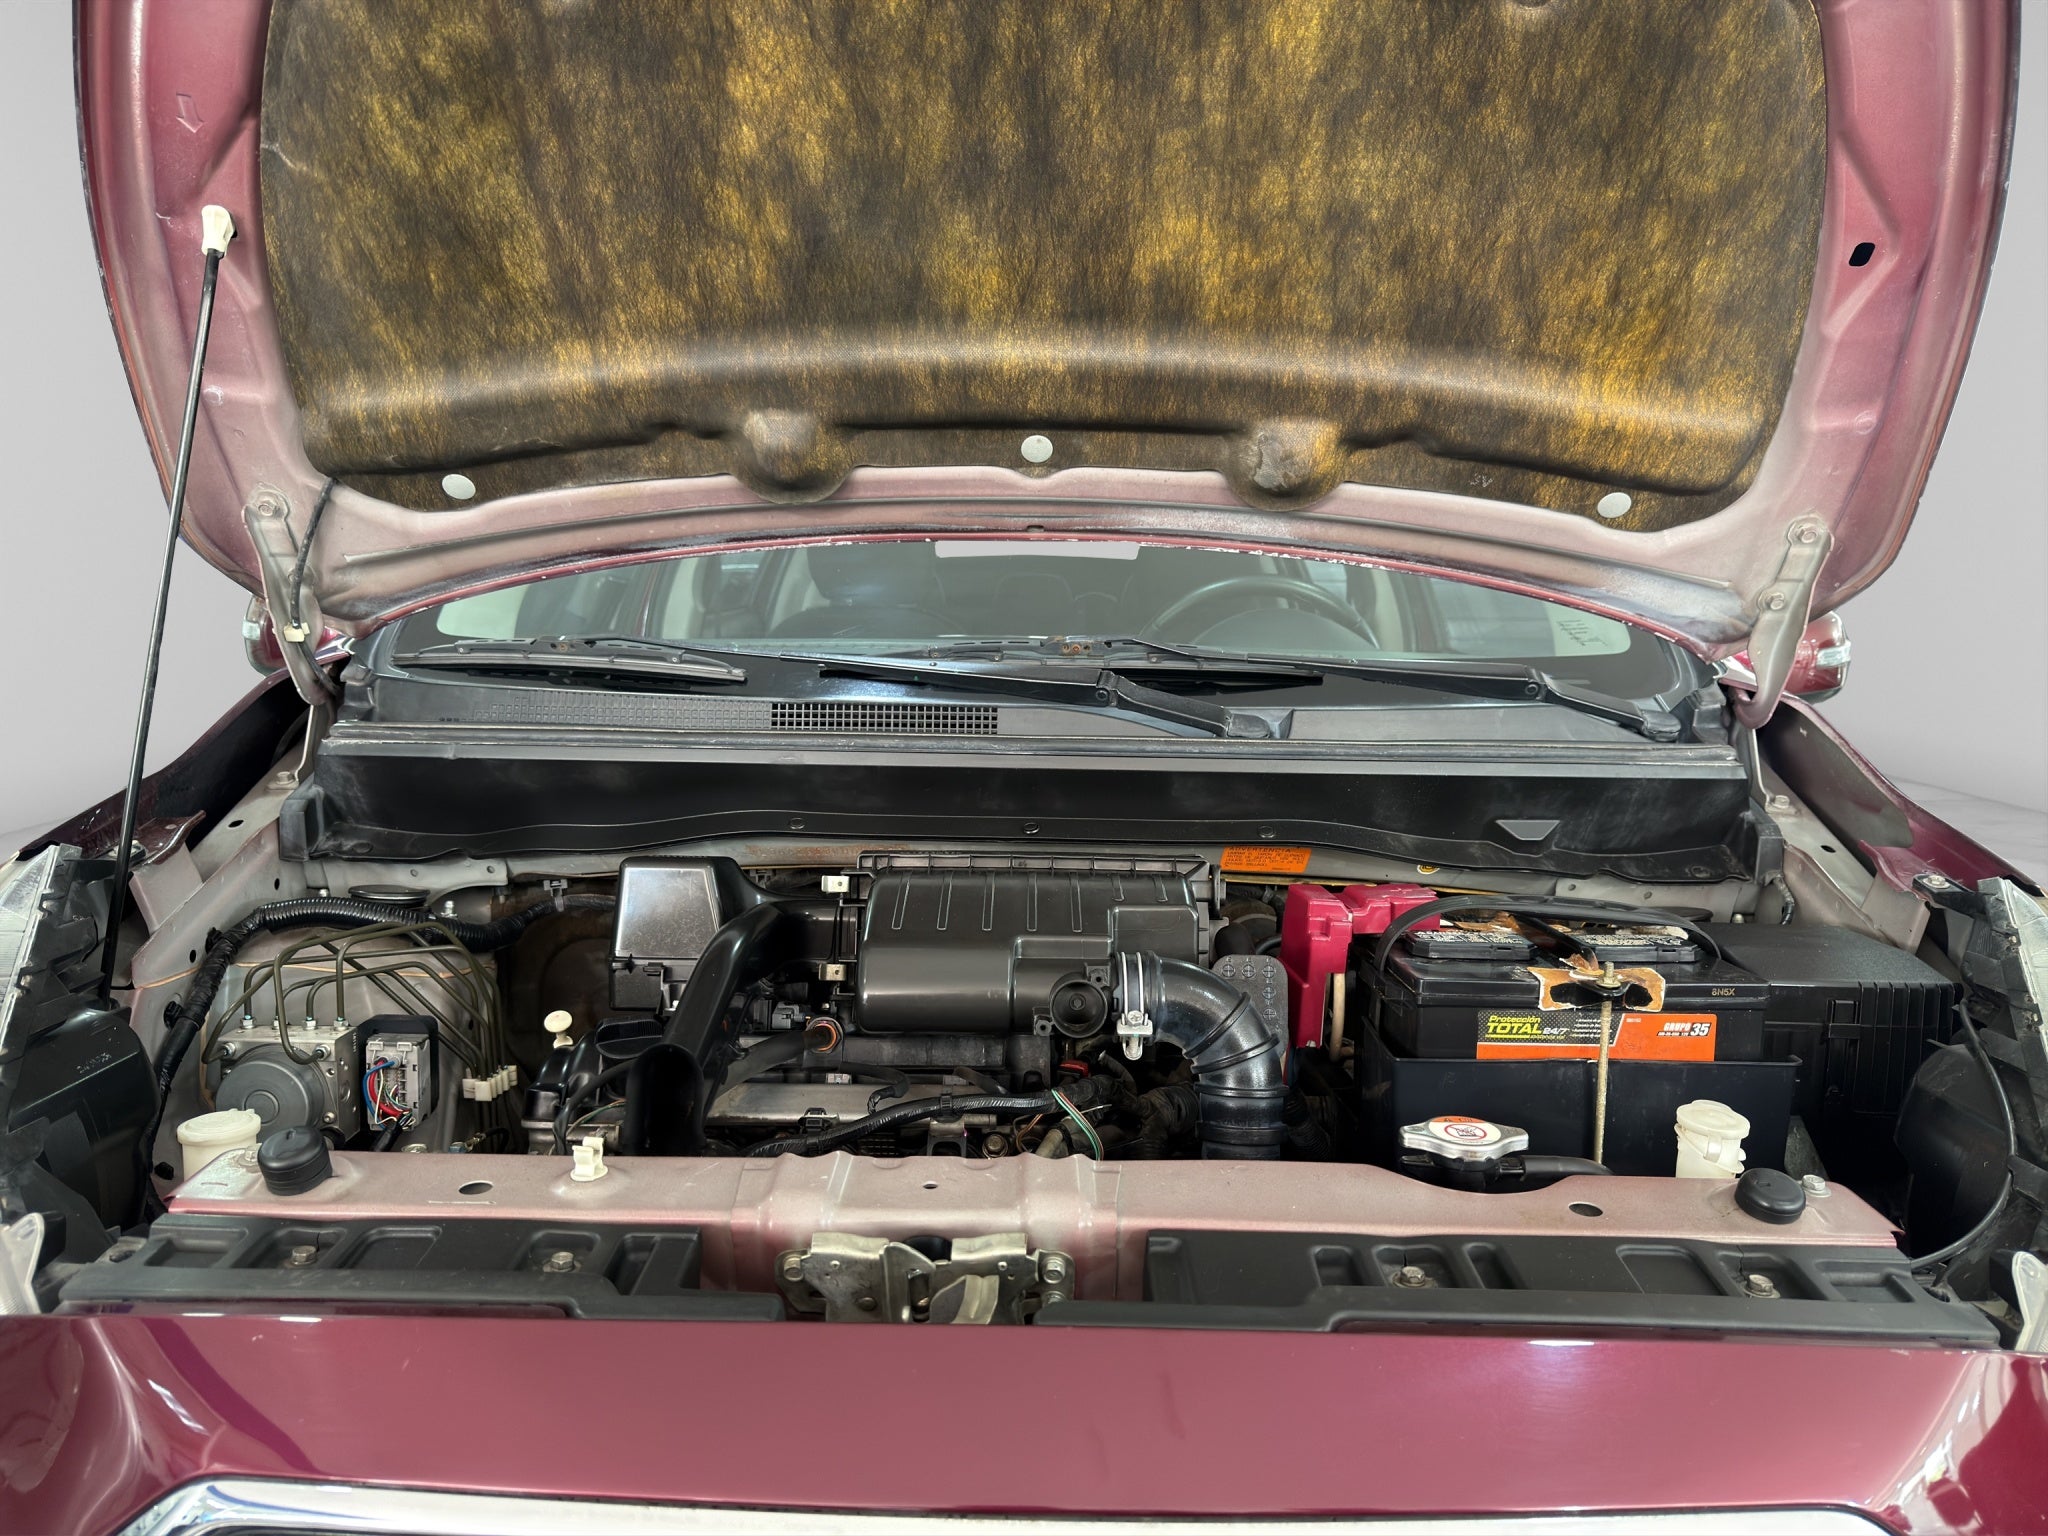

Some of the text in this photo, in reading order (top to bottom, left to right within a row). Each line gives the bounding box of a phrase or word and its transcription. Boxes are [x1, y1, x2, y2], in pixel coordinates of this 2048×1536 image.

[1489, 1015, 1540, 1023] Protección
[1487, 1023, 1541, 1034] TOTAL
[1542, 1027, 1568, 1035] 24/7
[1663, 1022, 1691, 1031] GRUPO
[1690, 1023, 1710, 1036] 35
